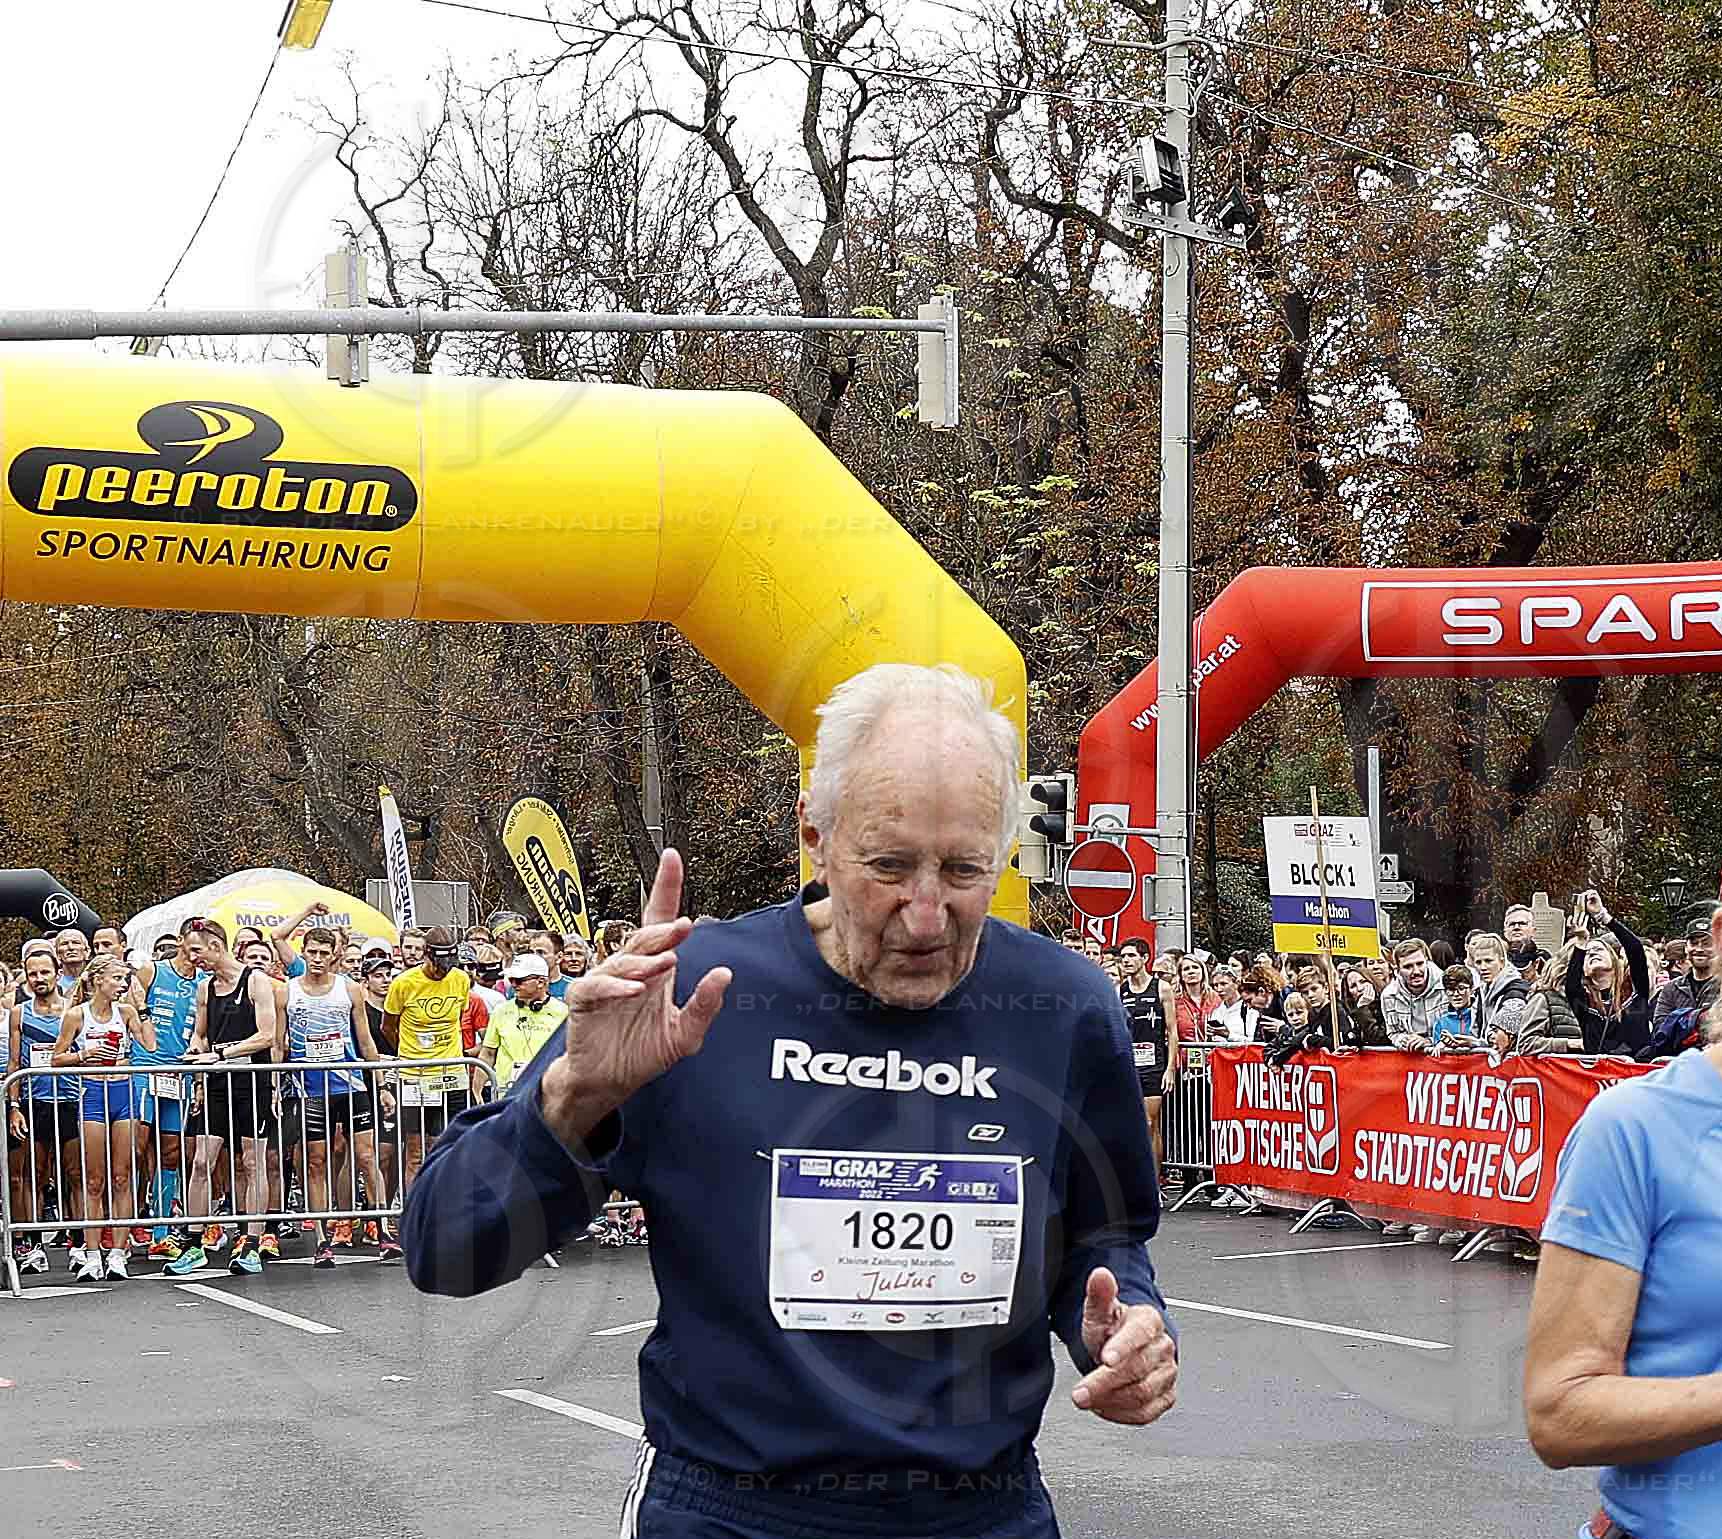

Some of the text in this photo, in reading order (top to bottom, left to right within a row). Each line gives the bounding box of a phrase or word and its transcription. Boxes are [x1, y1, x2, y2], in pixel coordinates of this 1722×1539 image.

[36, 531, 392, 571] SPORTNAHRUNG
[1348, 866, 1356, 887] 1
[48, 897, 78, 924] Buff
[771, 1038, 998, 1099] Reebok
[1235, 1064, 1303, 1112] WIENER
[1406, 1071, 1509, 1132] WIENER
[834, 1159, 894, 1178] GRAZ
[1354, 1132, 1502, 1198] STÄDTISCHE
[819, 1178, 875, 1189] MARATHON
[844, 1211, 953, 1251] 1820
[838, 1257, 955, 1267] Kleine Zeitung Marathon
[857, 1271, 936, 1301] Julius
